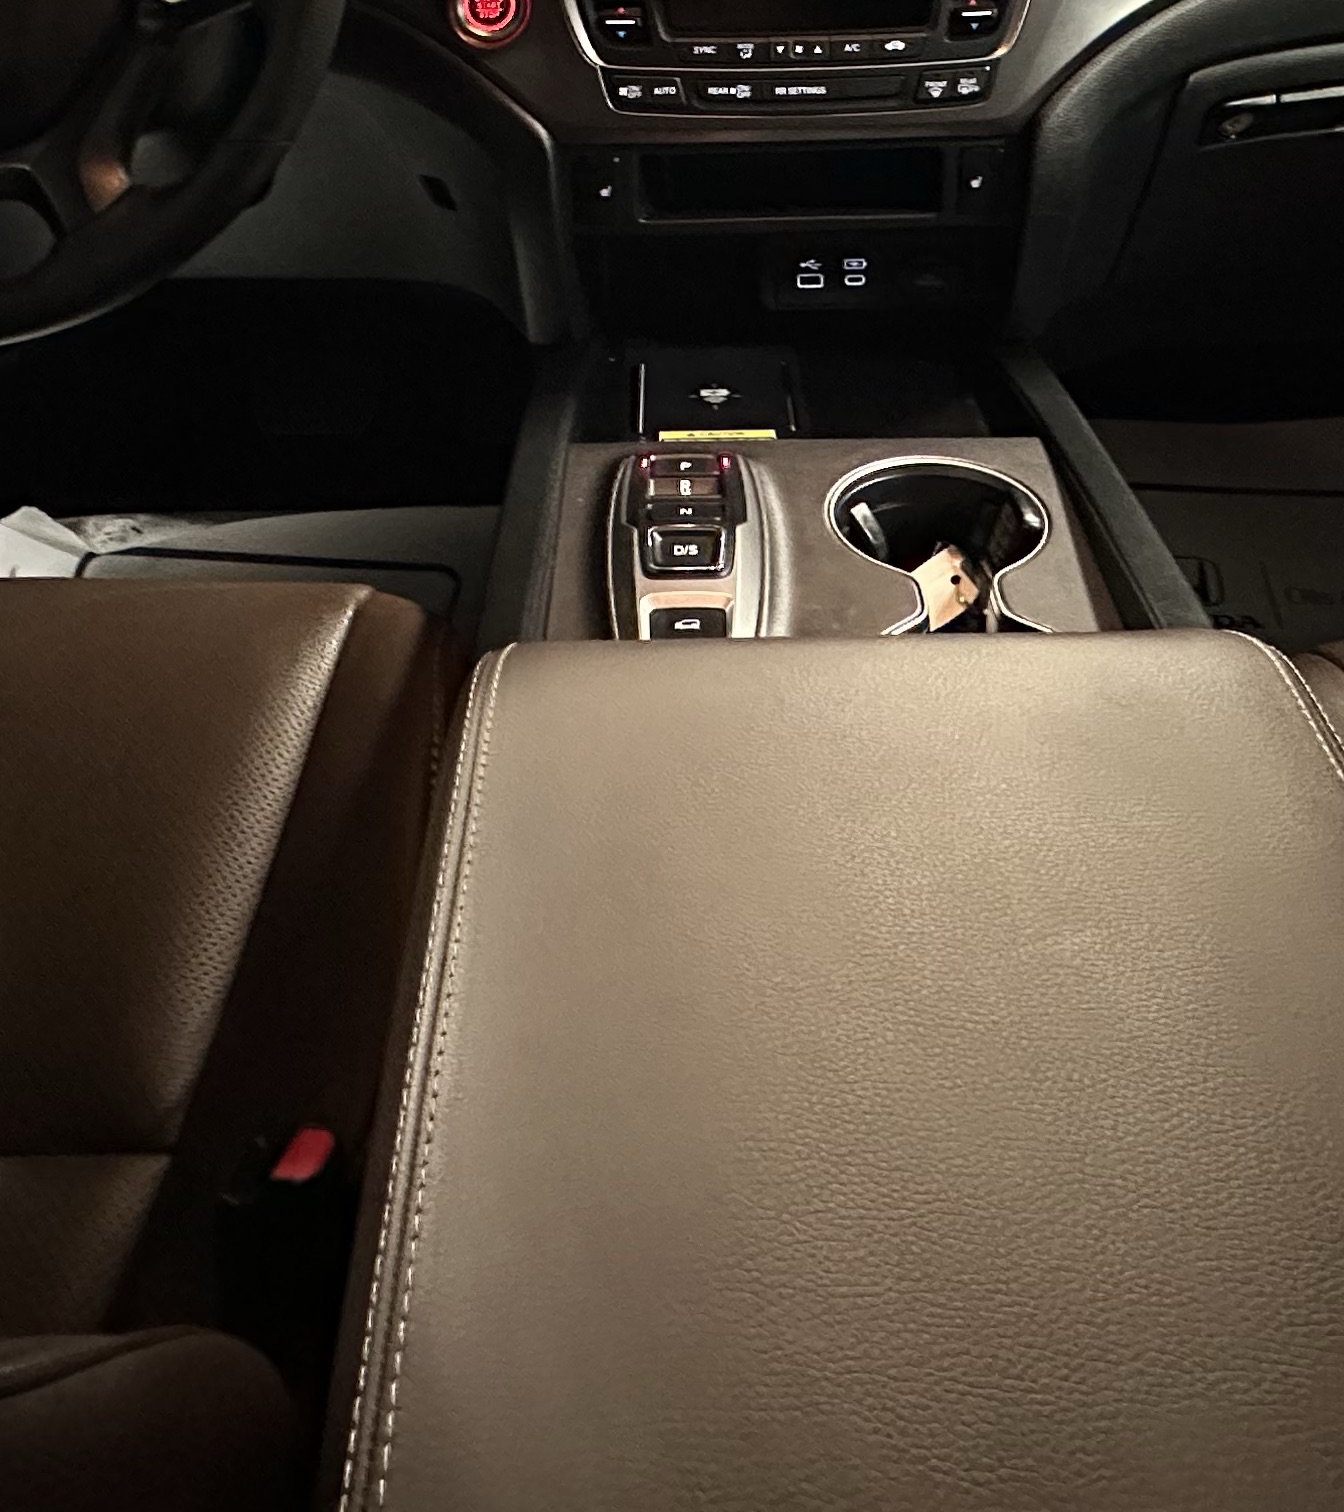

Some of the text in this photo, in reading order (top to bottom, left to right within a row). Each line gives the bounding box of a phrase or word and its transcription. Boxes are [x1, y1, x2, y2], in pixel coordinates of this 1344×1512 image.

[693, 46, 717, 55] SYNC
[653, 86, 676, 95] AUTO
[707, 86, 729, 95] REAR
